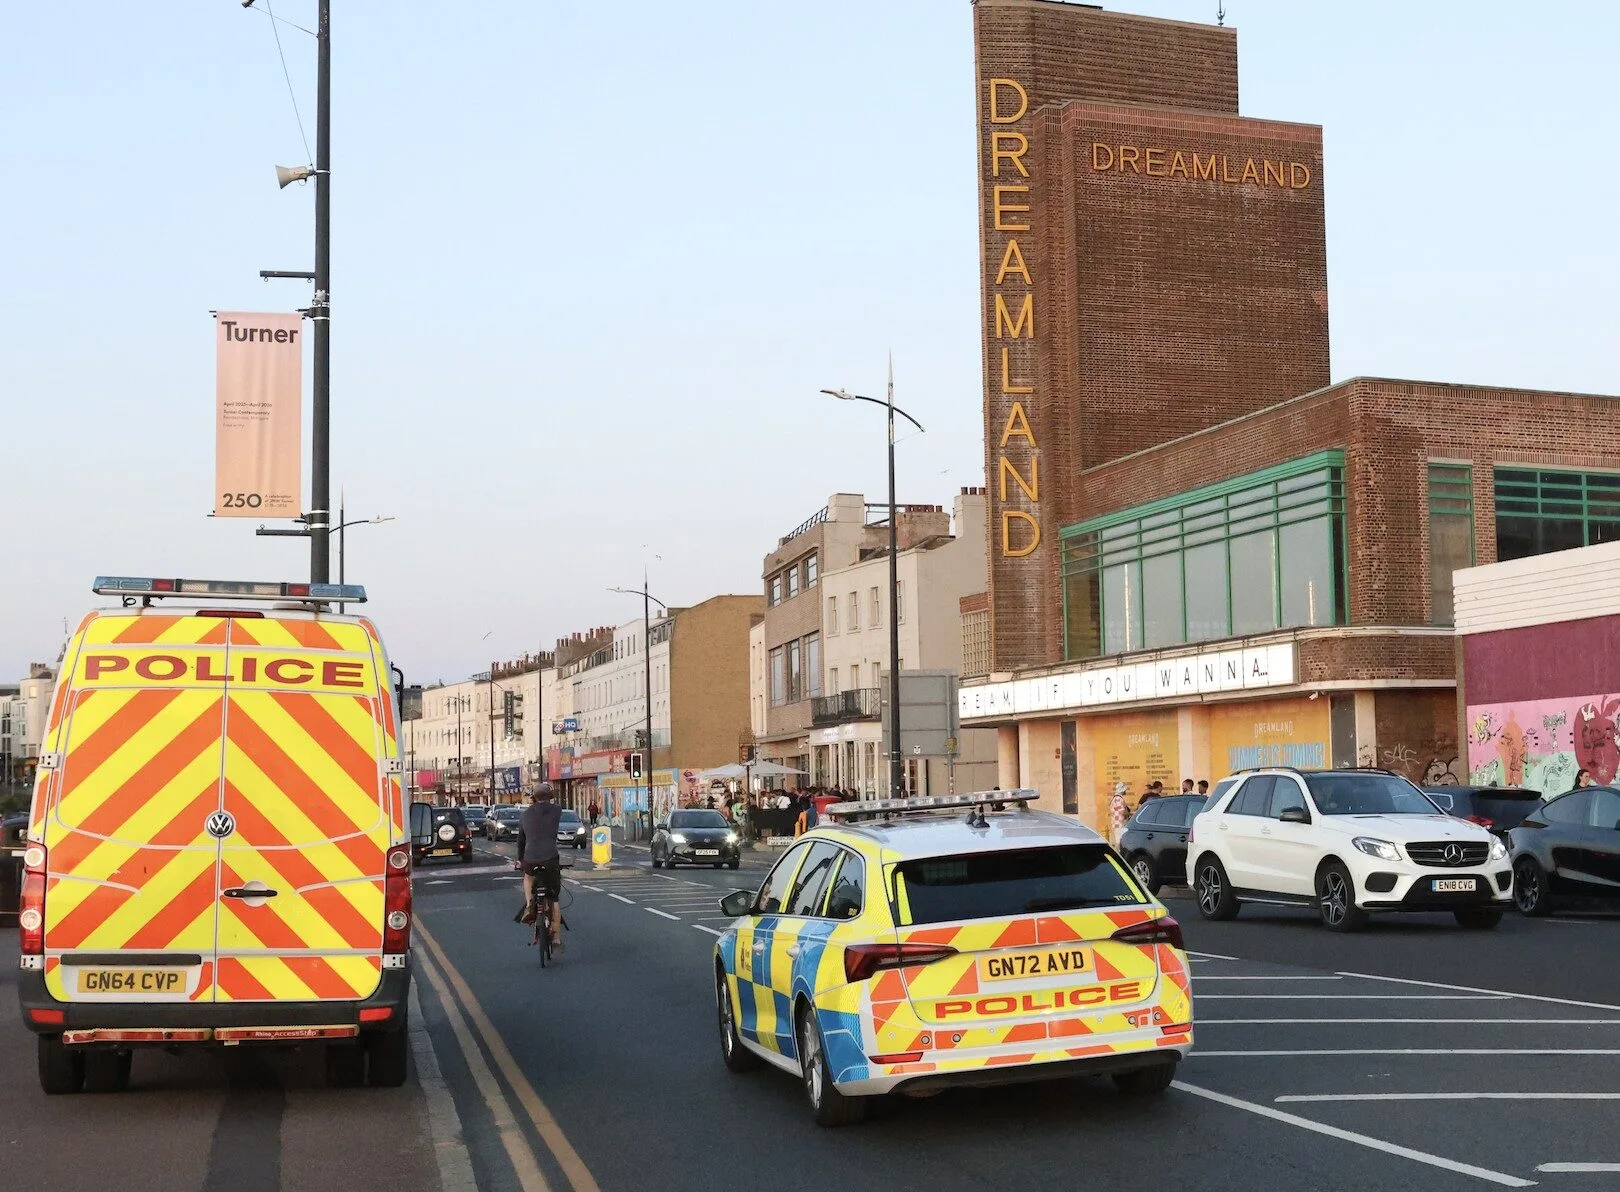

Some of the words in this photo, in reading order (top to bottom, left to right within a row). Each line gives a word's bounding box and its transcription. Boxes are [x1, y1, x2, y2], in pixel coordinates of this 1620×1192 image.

[1092, 142, 1310, 189] DREAMLAND
[990, 78, 1041, 557] DREAMLAND
[221, 321, 298, 343] Turner
[222, 493, 262, 508] 250
[85, 655, 364, 688] POLICE
[963, 690, 1011, 710] REAM
[1037, 683, 1059, 703] IF
[1088, 674, 1131, 697] YOU
[1254, 720, 1294, 738] DREAMLAND
[1228, 743, 1268, 771] SUMMER
[1271, 743, 1281, 769] IS
[1438, 881, 1457, 890] EN18
[1458, 881, 1473, 890] CVG
[988, 955, 1041, 977] GN72
[1047, 951, 1084, 972] AVD
[86, 973, 135, 990] GN64
[141, 973, 178, 990] CVP
[935, 982, 1140, 1019] POLICE
